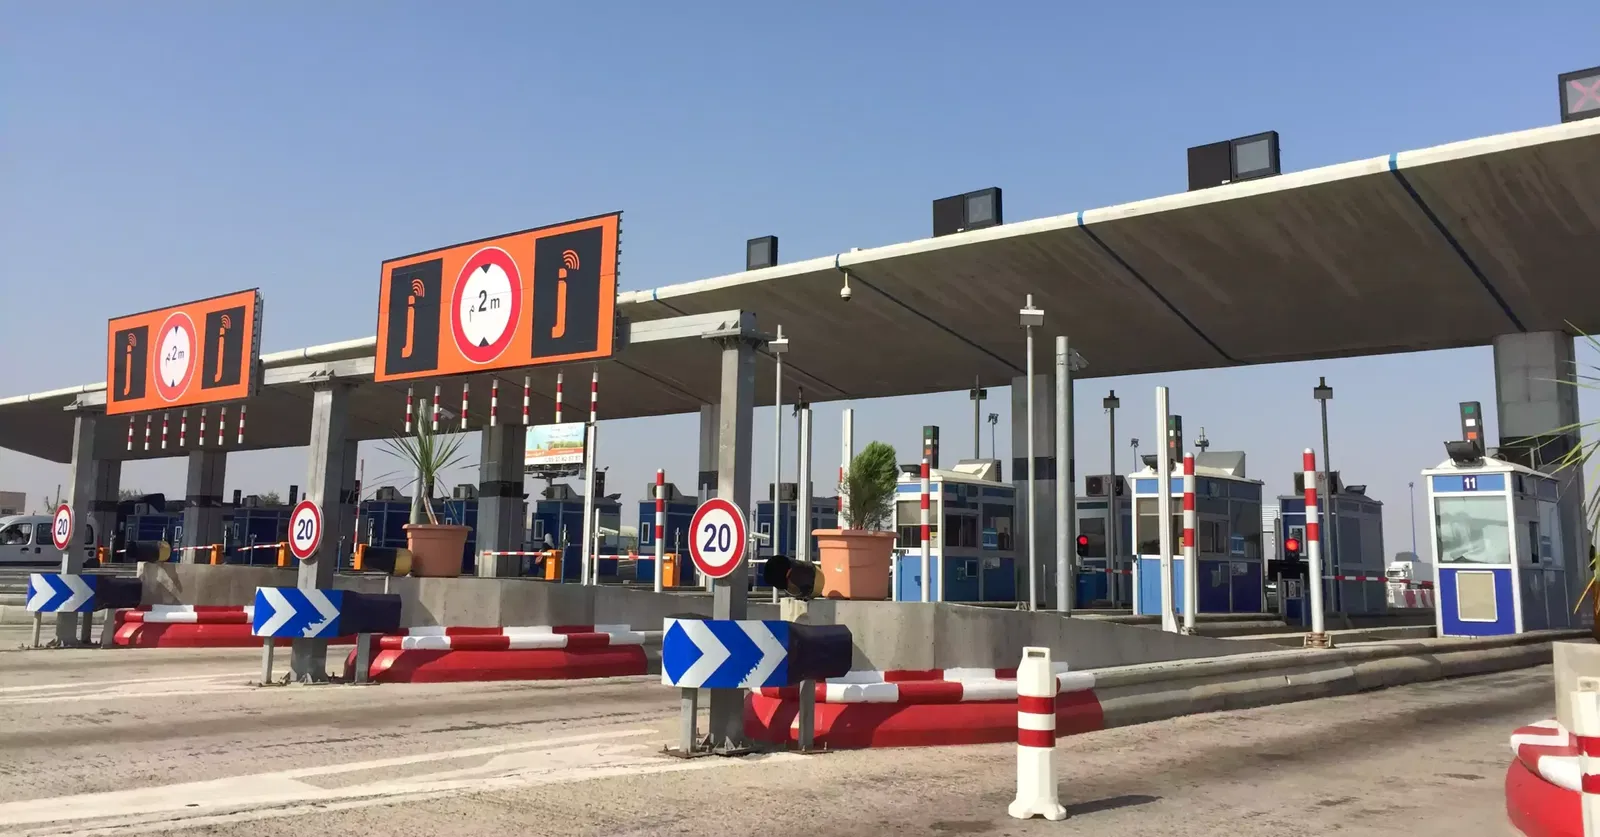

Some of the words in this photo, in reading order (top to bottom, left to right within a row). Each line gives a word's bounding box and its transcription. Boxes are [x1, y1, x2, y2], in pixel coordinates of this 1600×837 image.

[478, 290, 487, 313] 2
[490, 296, 500, 309] m
[172, 346, 177, 361] 2
[177, 351, 185, 359] m
[1464, 477, 1476, 489] 11
[57, 519, 68, 535] 20
[297, 519, 313, 540] 20
[703, 523, 731, 552] 20
